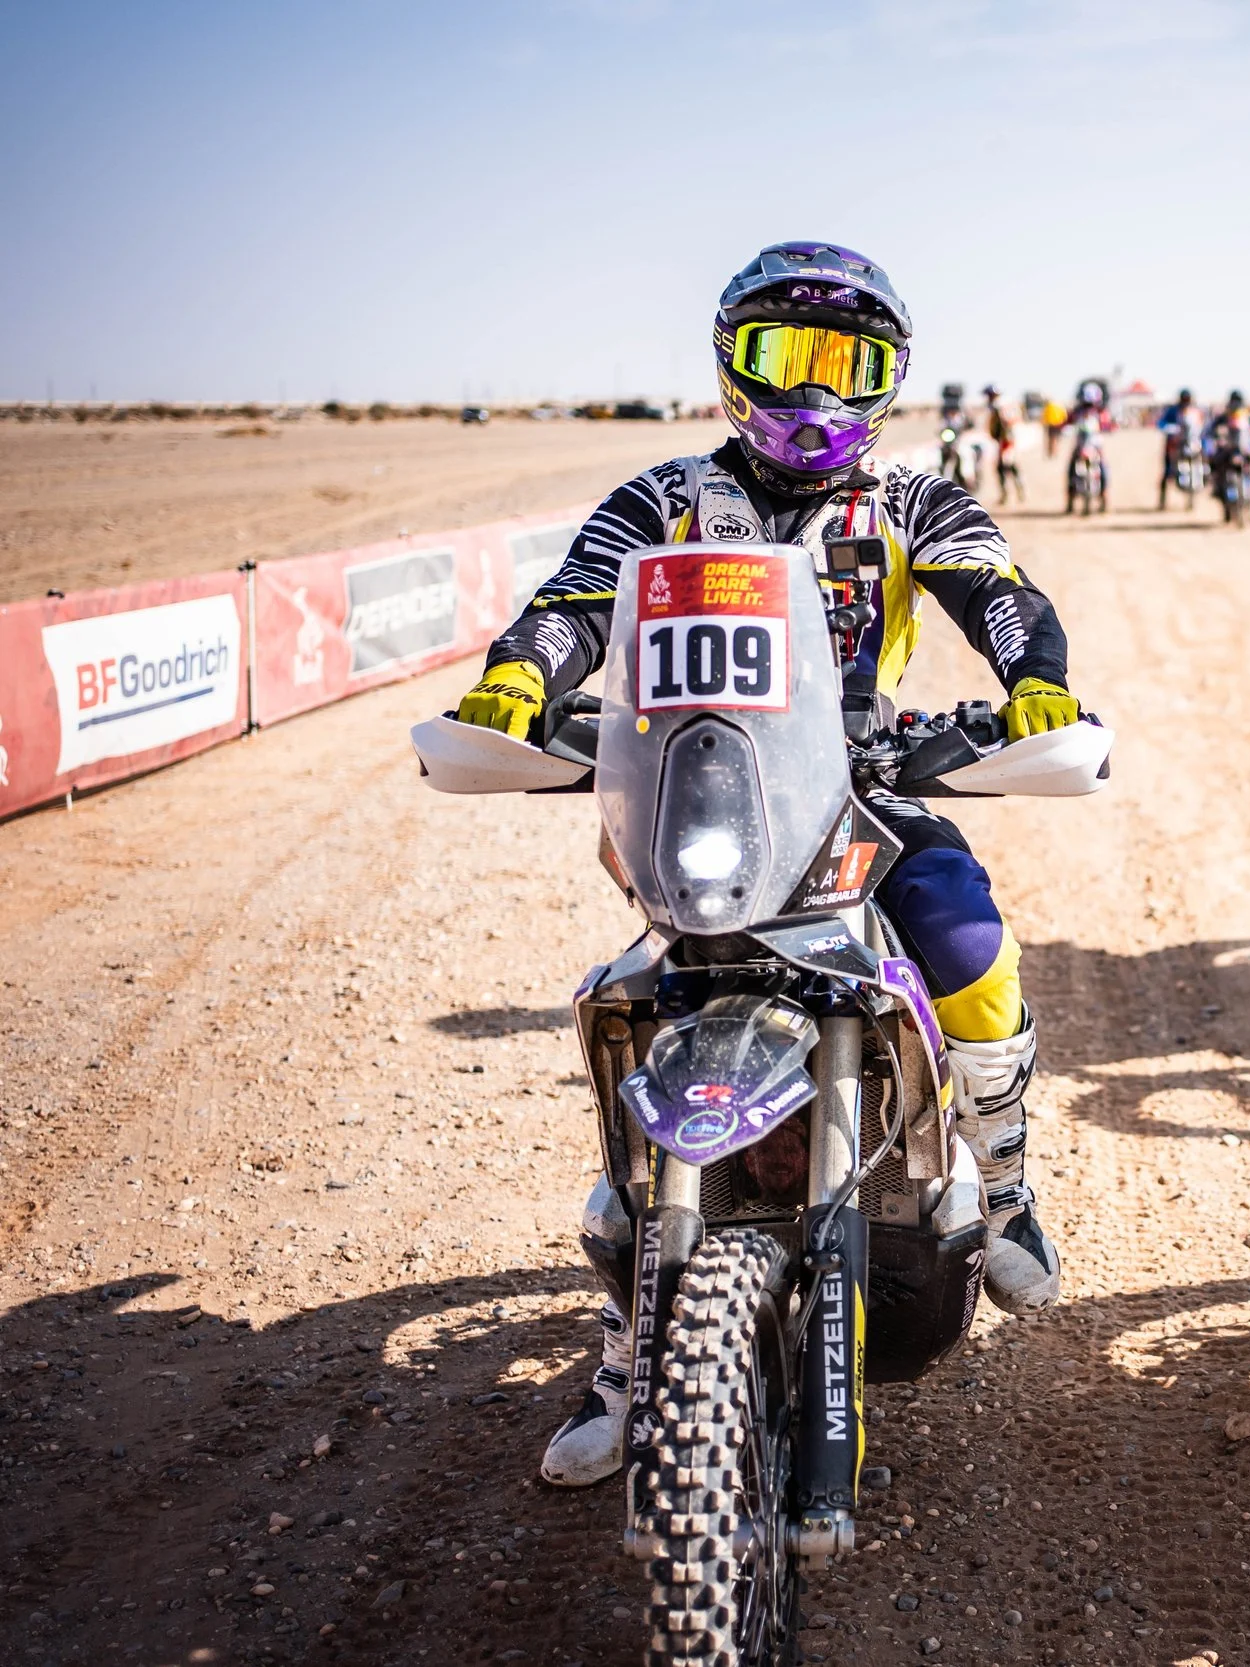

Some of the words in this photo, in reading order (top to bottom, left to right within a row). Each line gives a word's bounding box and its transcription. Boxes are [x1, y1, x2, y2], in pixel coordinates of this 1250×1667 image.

[713, 524, 750, 536] DMJ
[703, 562, 770, 579] DREAM.
[703, 577, 754, 591] DARE.
[703, 591, 742, 605] LIVE
[743, 593, 763, 606] IT.
[76, 635, 229, 711] BFGoodrich
[649, 624, 772, 699] 109
[634, 1087, 660, 1124] Bennetts
[632, 1220, 663, 1404] METZELER
[960, 1273, 980, 1329] Bennetts
